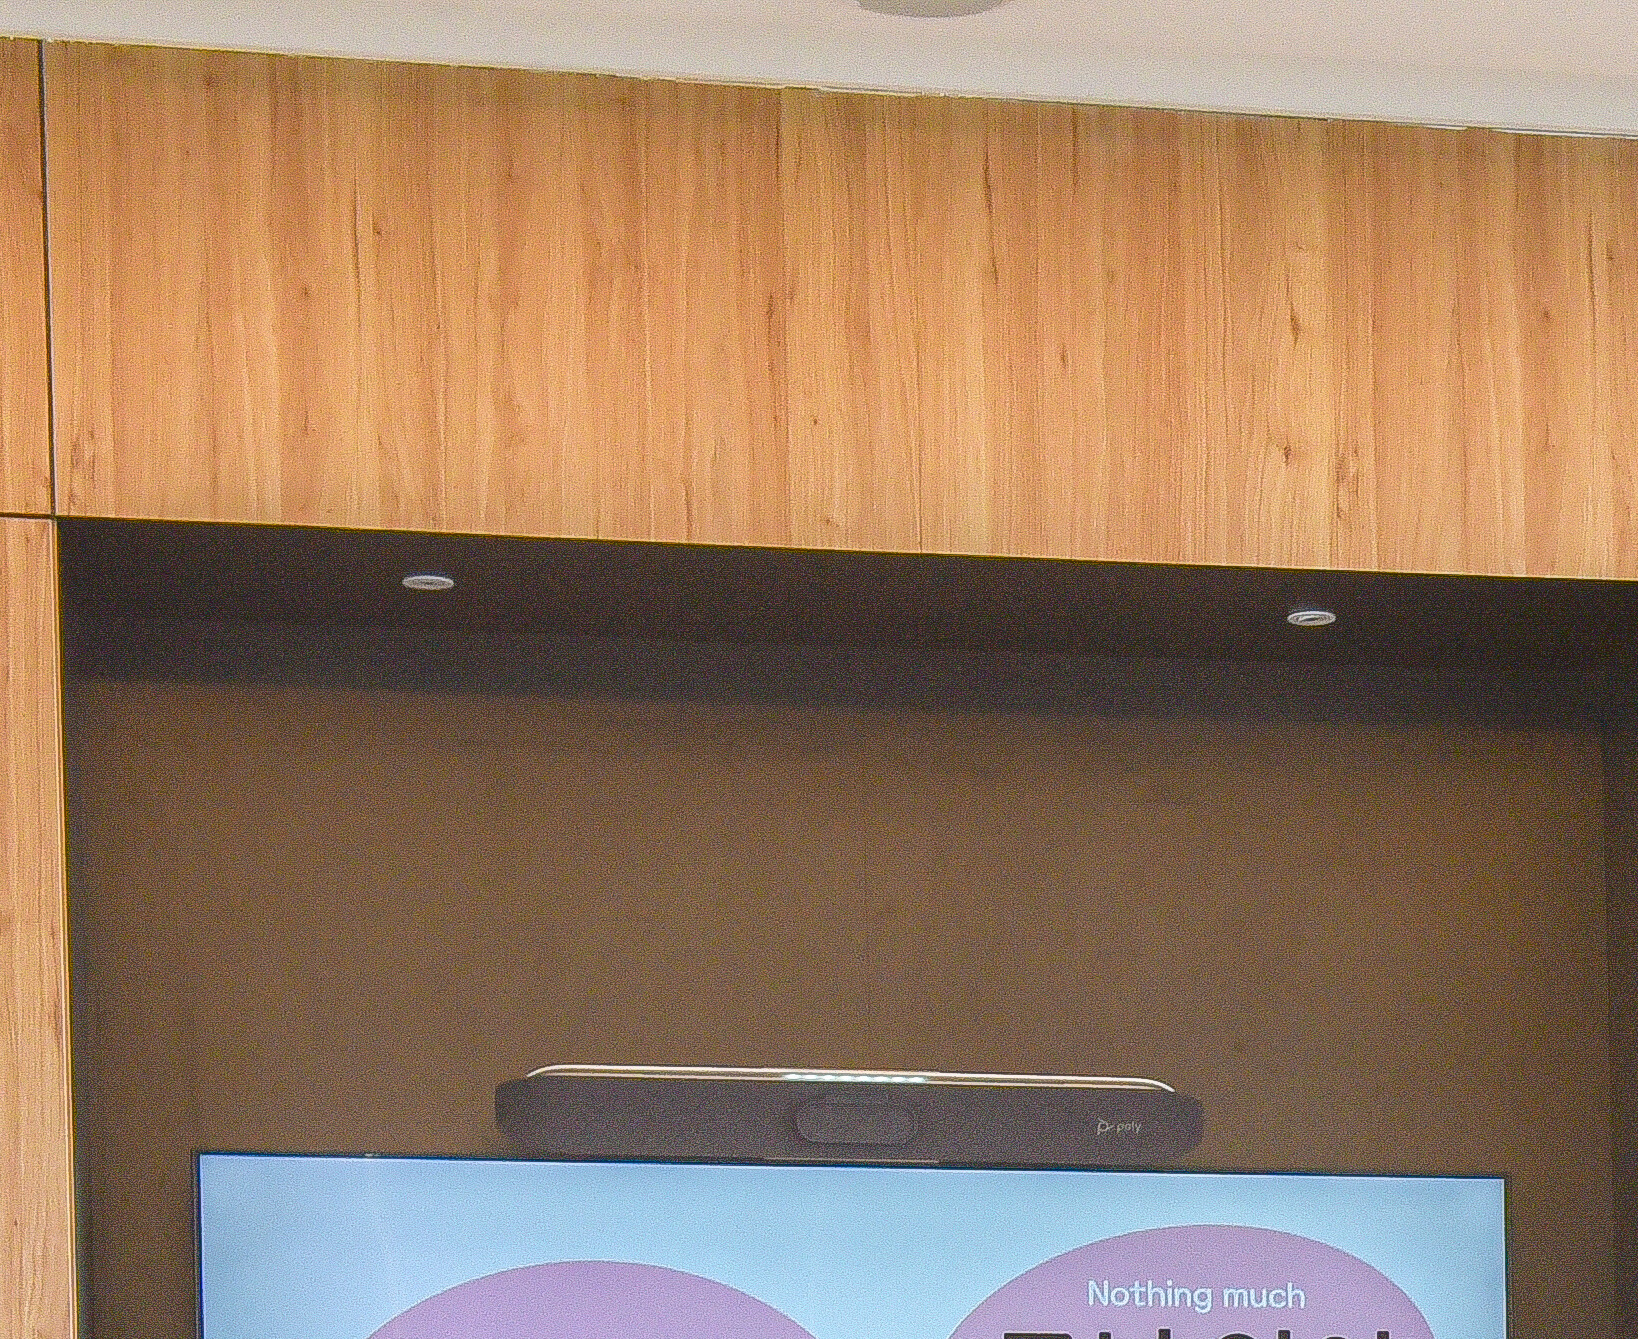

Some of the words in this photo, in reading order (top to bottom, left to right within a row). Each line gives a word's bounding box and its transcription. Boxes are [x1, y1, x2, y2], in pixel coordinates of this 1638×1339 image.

[1116, 1121, 1142, 1135] poly
[1088, 1280, 1213, 1313] Nothing
[1222, 1282, 1306, 1309] much
